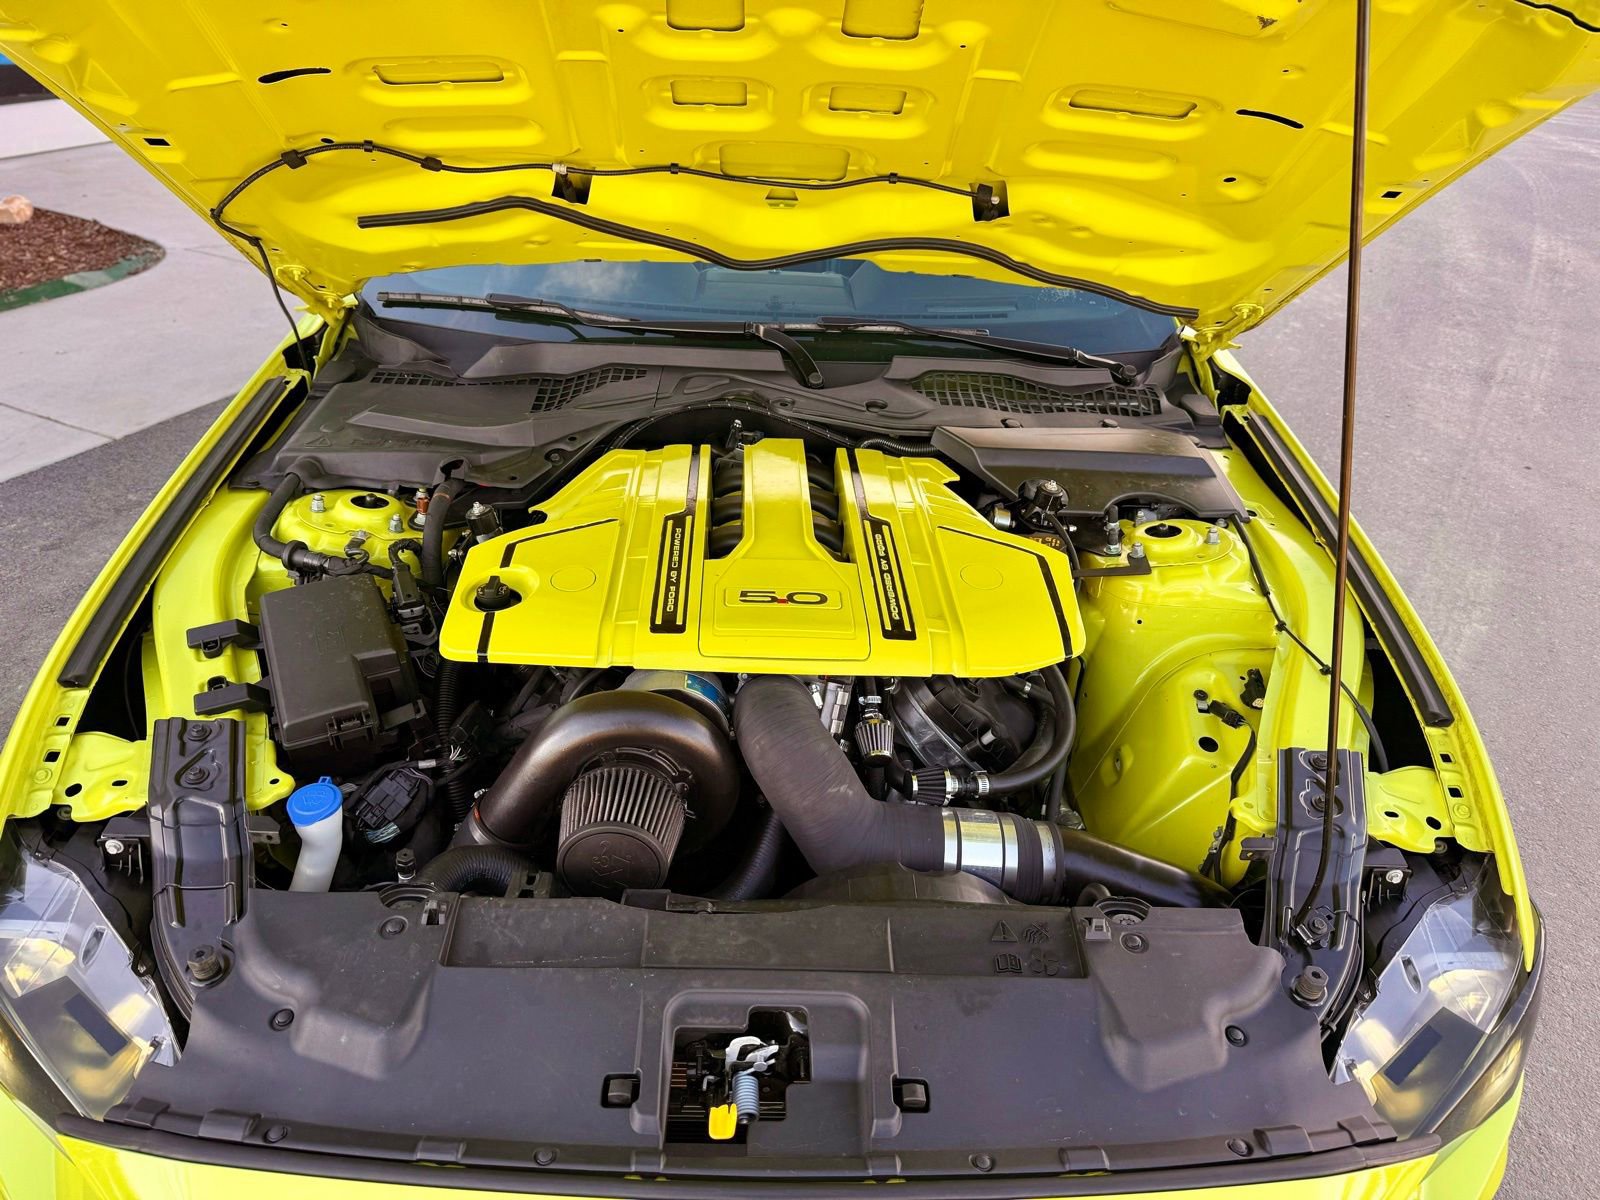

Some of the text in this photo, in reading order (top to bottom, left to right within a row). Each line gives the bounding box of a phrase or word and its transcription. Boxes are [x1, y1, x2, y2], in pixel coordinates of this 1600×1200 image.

[666, 527, 682, 612] POWERED BY FORD
[738, 590, 829, 605] 5.0
[875, 533, 900, 620] POWERED BY FORD
